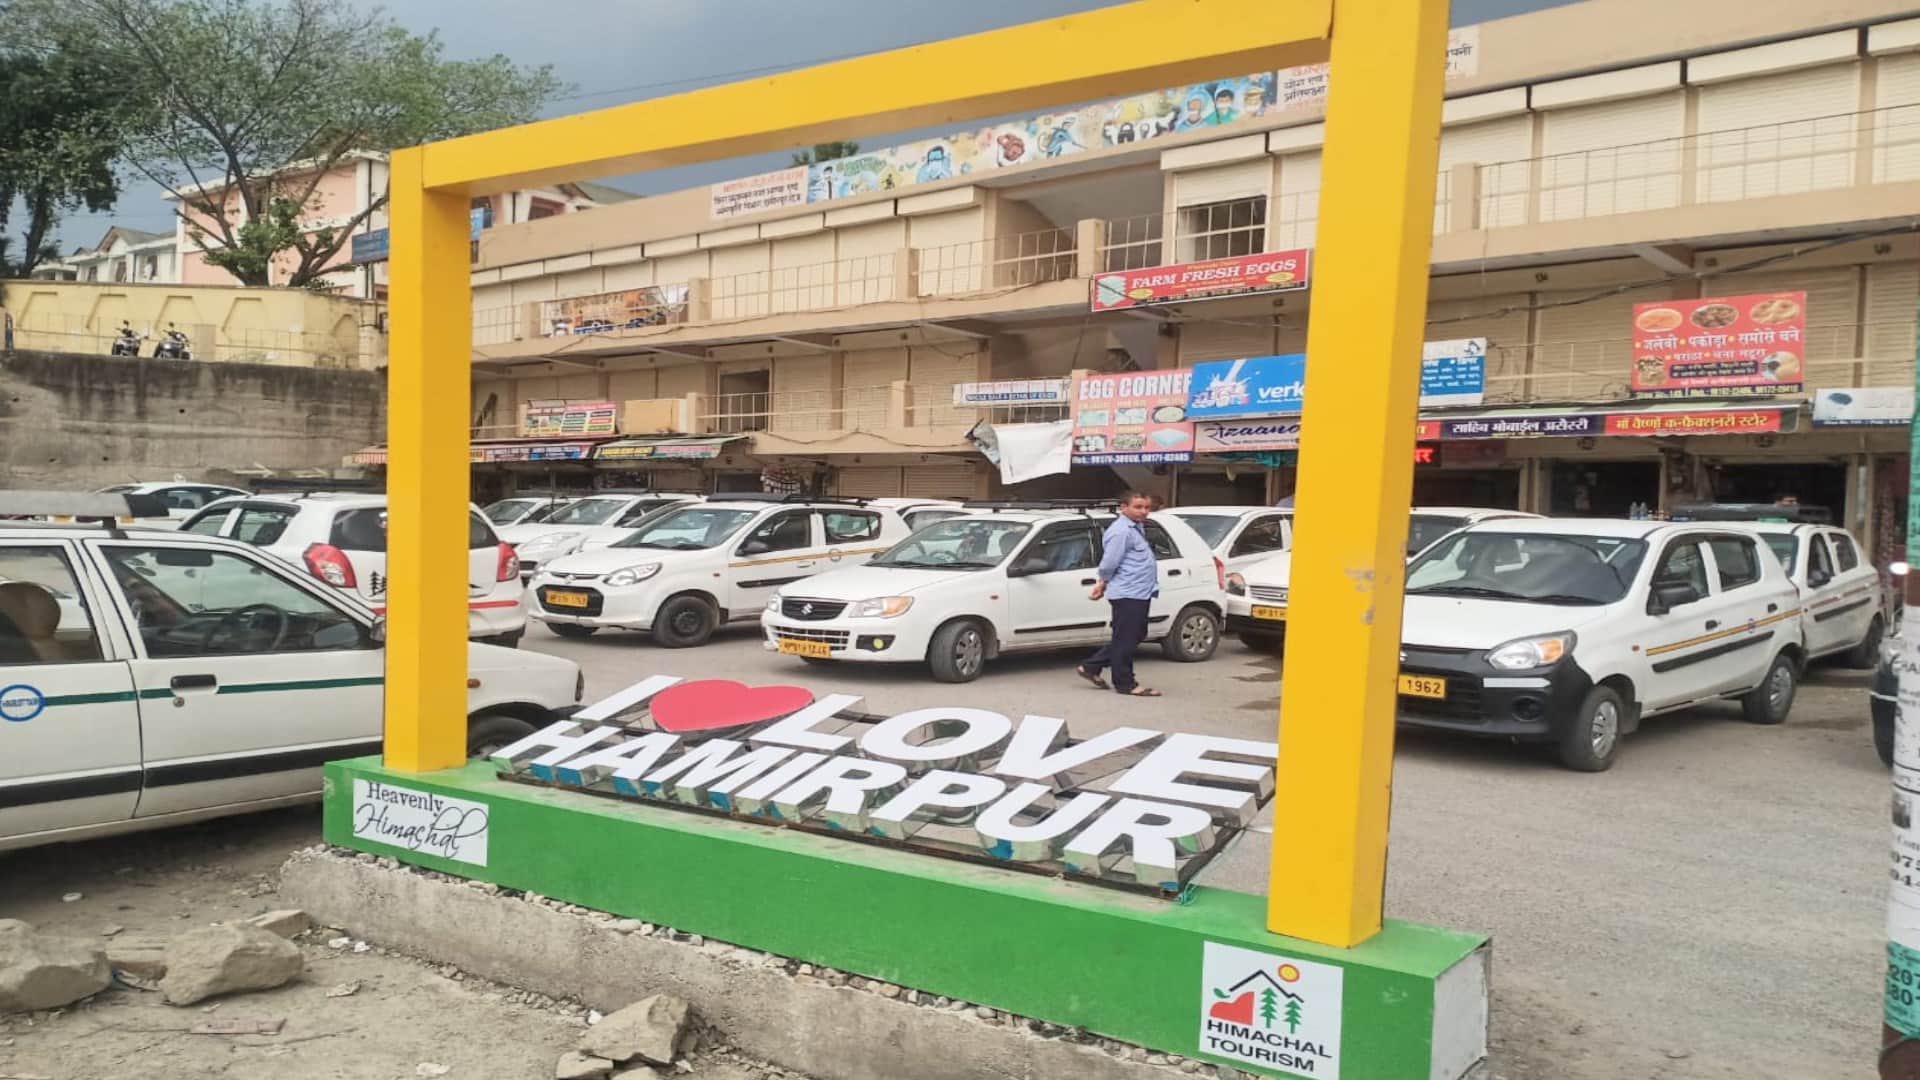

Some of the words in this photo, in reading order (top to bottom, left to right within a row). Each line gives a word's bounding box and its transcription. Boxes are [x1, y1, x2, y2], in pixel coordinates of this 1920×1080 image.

[1132, 273, 1176, 290] FARM
[1181, 265, 1240, 283] FRESH
[1245, 258, 1298, 275] EGGS
[1079, 379, 1115, 401] EGG
[1407, 679, 1441, 695] 1962
[571, 675, 683, 720] I
[750, 692, 1280, 812] LOVE
[367, 780, 444, 816] Heavenly
[490, 719, 1214, 869] HAMIRPUR
[353, 802, 489, 859] Himachal
[1207, 1018, 1333, 1059] HIMACHAL
[1207, 1035, 1315, 1072] TOURISM
